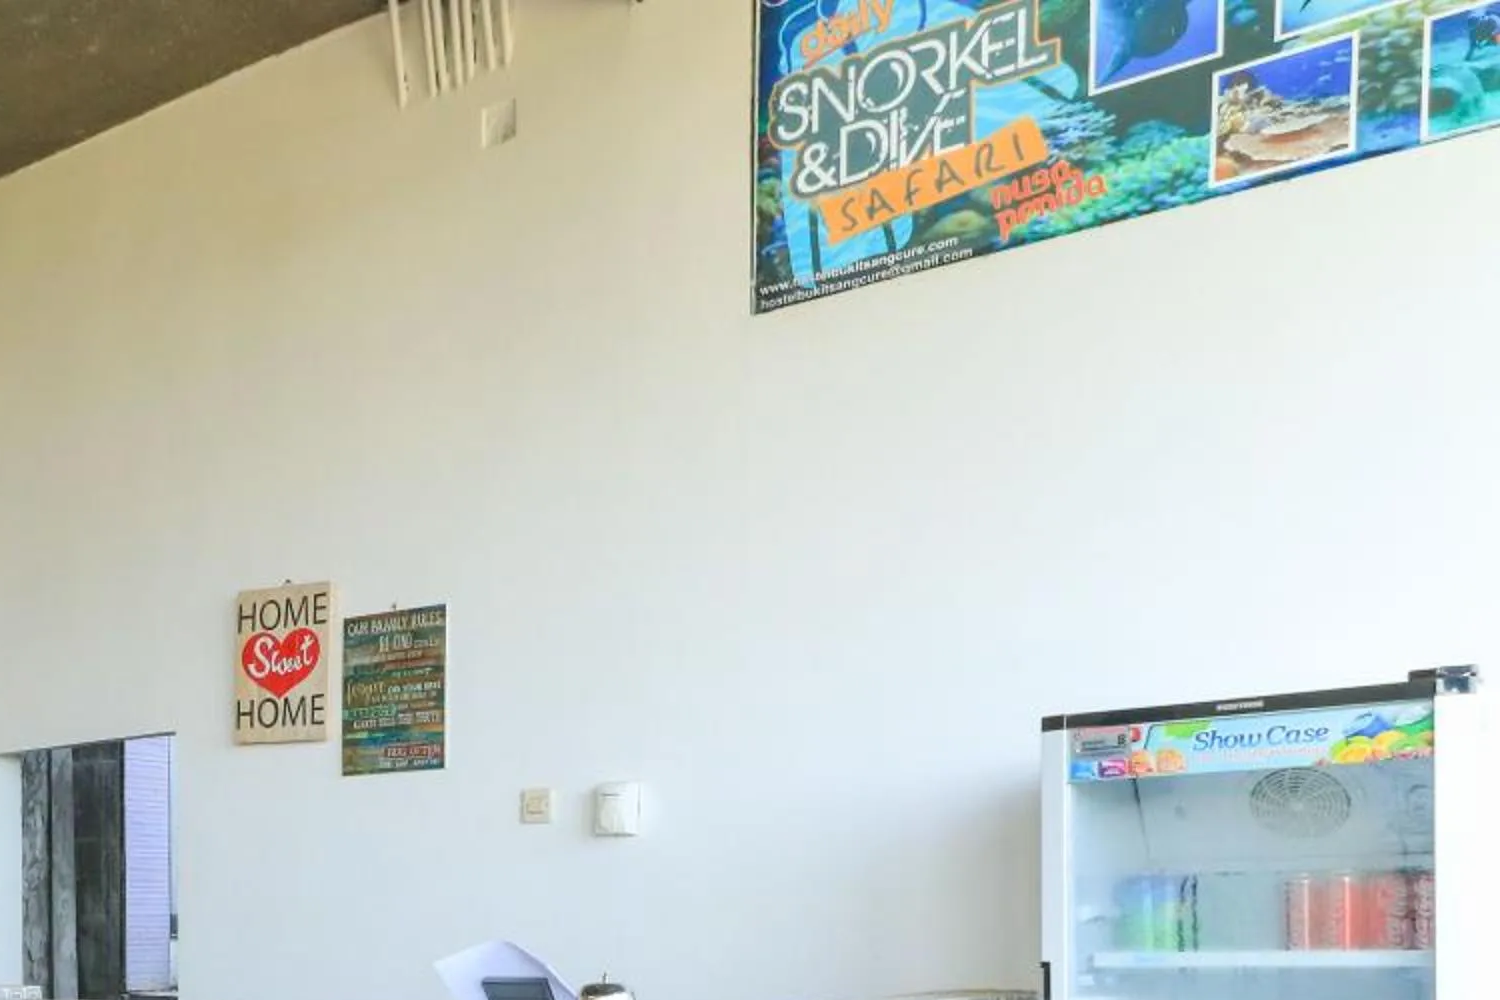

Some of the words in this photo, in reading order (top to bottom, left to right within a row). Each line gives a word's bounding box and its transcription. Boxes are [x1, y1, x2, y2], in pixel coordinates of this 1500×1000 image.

[777, 7, 1049, 142] SNORKEL
[840, 132, 1026, 233] SAFARI
[237, 591, 328, 634] HOME
[247, 634, 316, 679] Sweet
[235, 693, 326, 730] HOME
[1192, 728, 1263, 752] Show
[1265, 724, 1331, 747] Case
